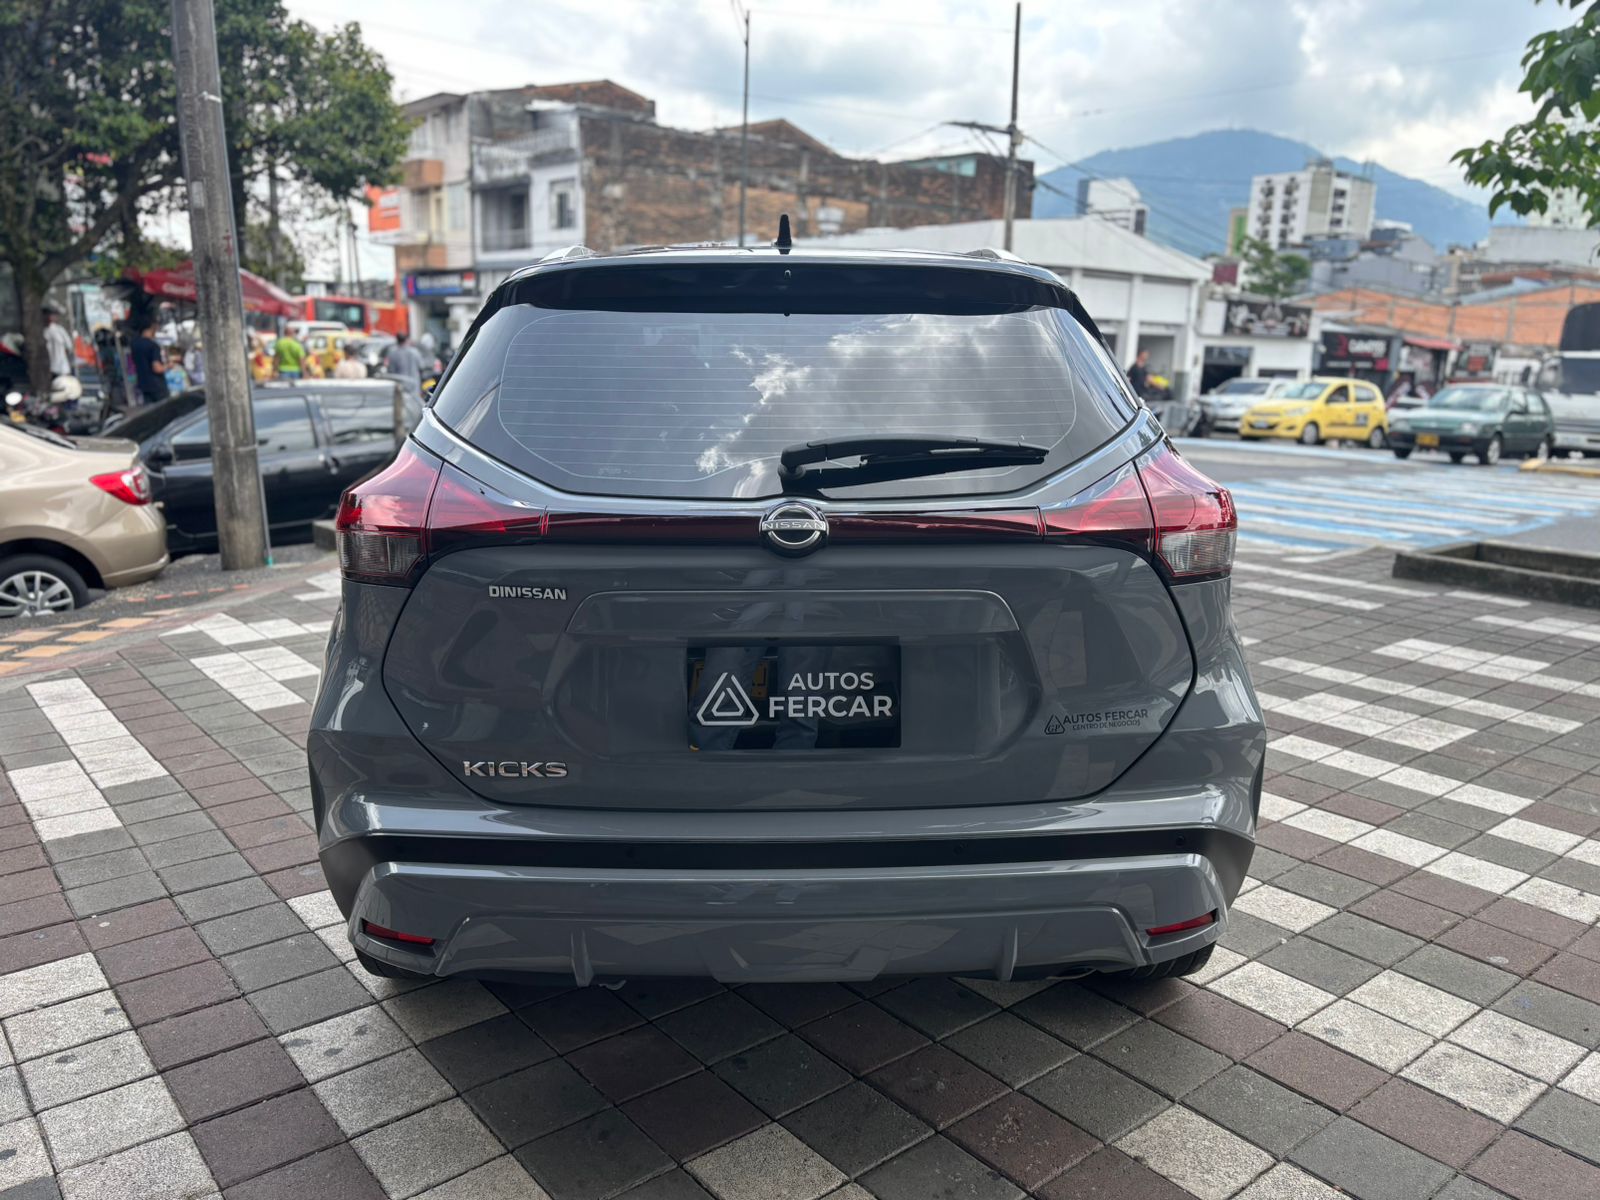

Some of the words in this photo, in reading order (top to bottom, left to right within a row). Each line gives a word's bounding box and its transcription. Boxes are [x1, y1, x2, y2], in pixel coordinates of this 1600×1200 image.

[764, 521, 824, 529] NISSAN
[488, 585, 567, 600] DINISSAN
[787, 672, 875, 691] AUTOS
[769, 695, 893, 718] FERCAR
[1063, 713, 1102, 725] AUTOS
[1105, 709, 1148, 721] FERCAR
[463, 761, 567, 778] KICKS
